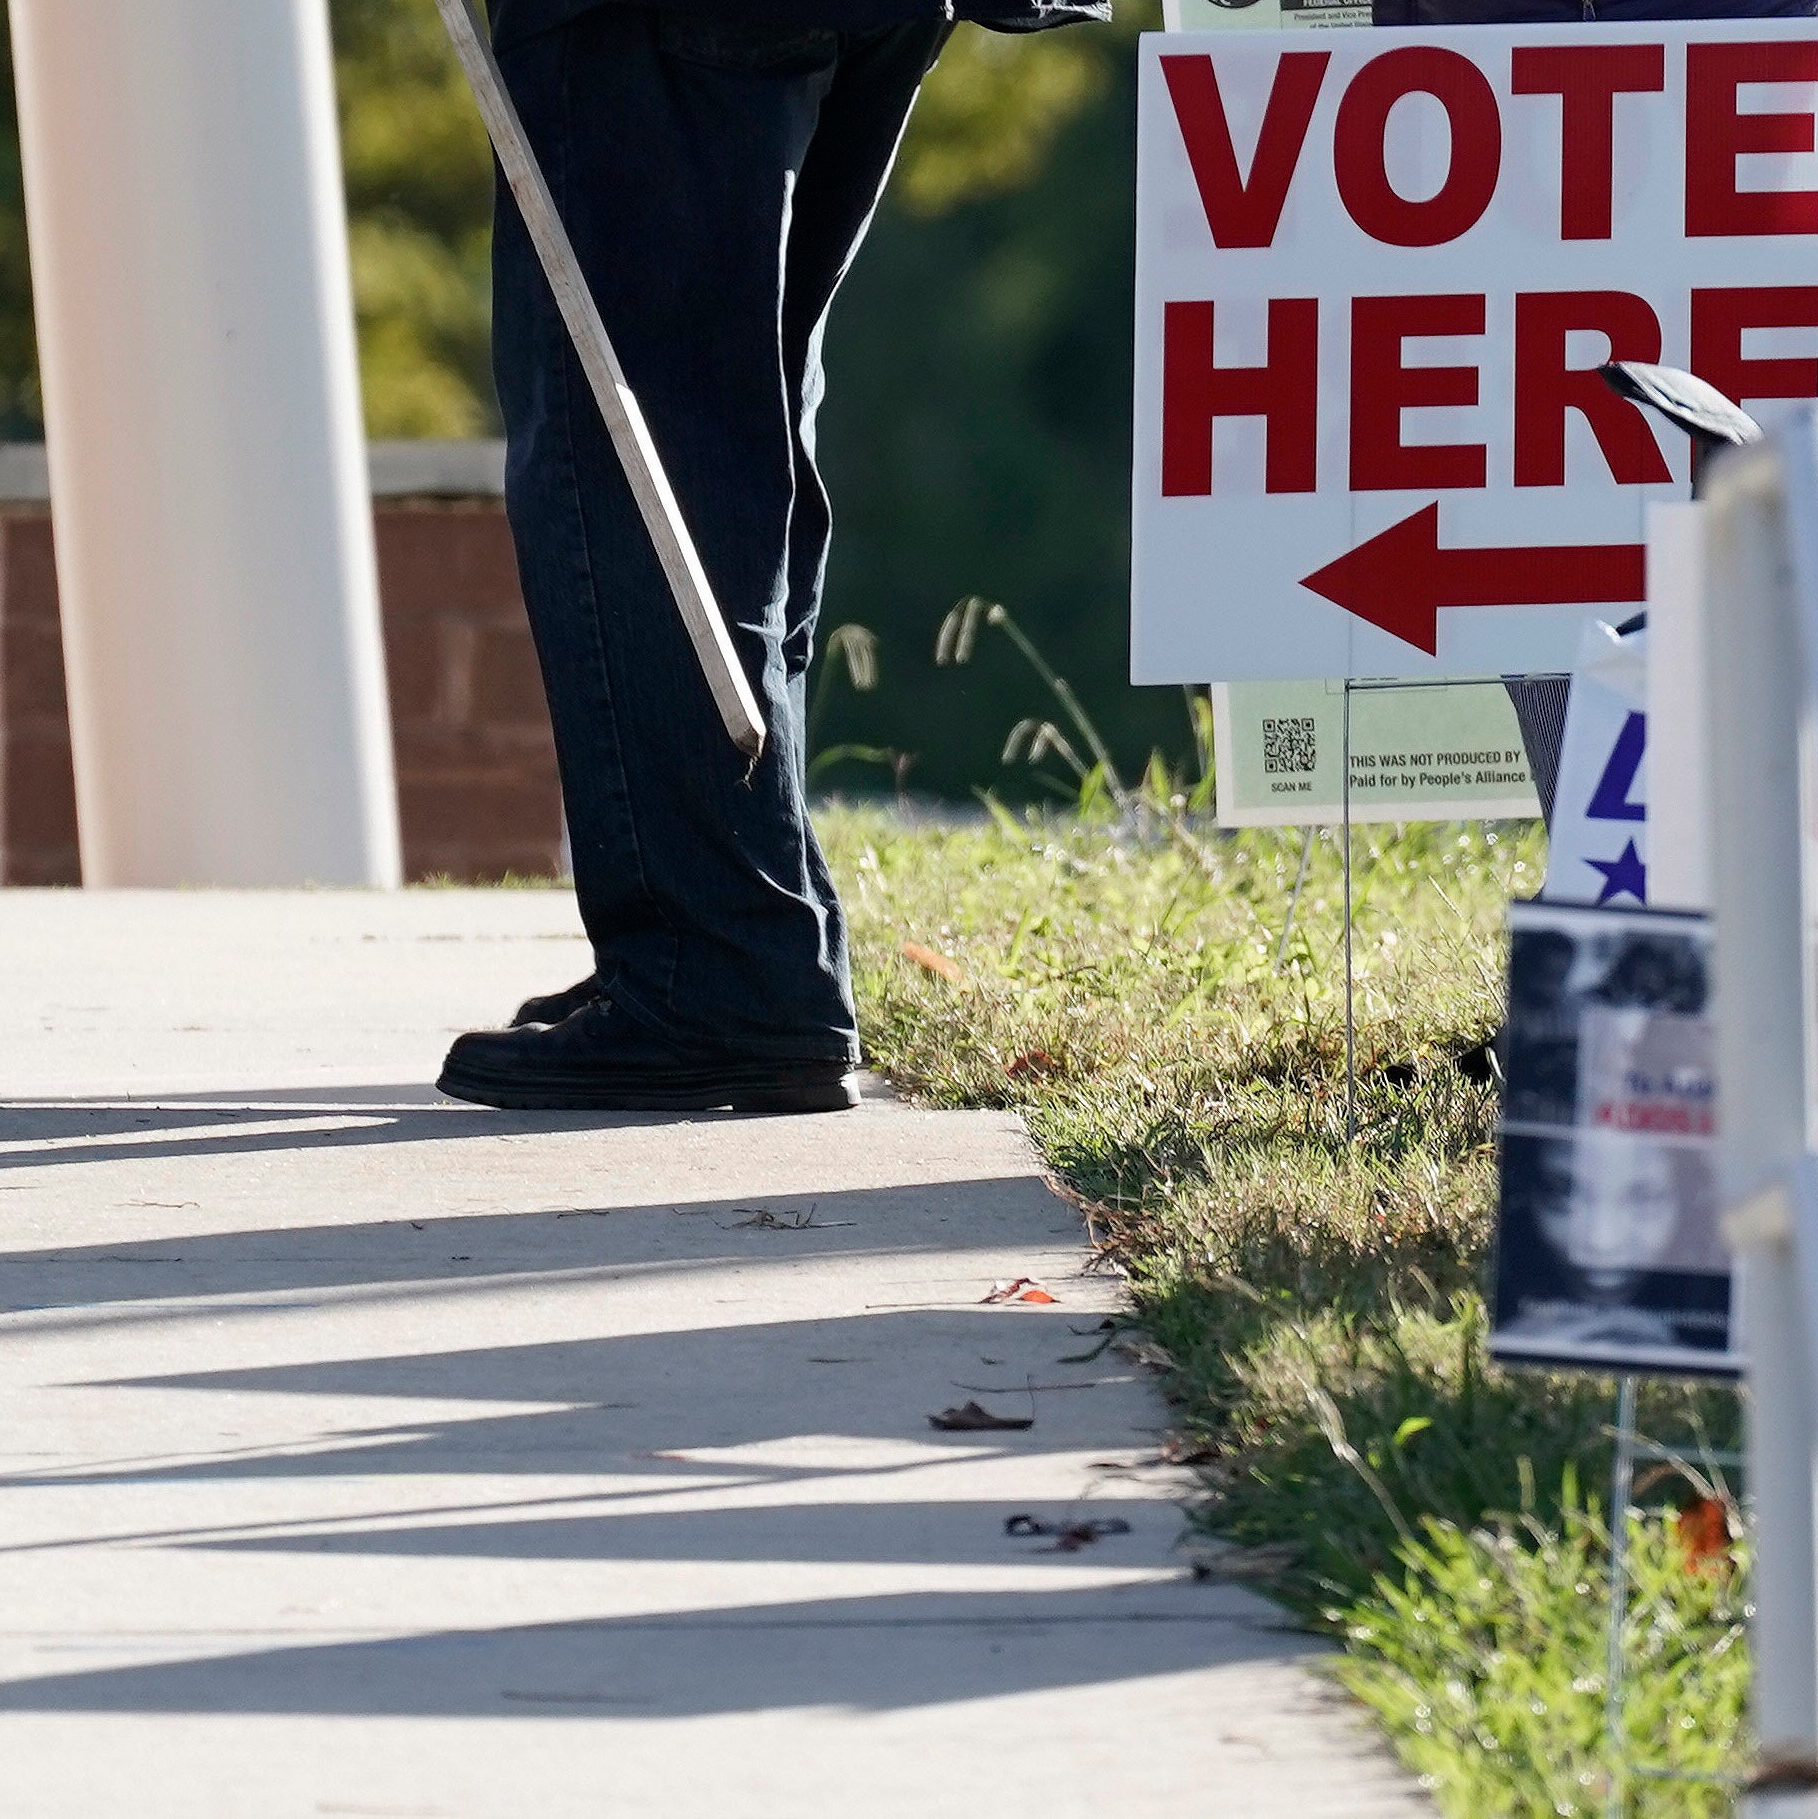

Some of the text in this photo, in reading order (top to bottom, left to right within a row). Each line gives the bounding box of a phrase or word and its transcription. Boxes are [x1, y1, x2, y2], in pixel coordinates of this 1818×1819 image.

[1350, 750, 1521, 768] THIS WAS NOT PRODUCED BY
[1271, 781, 1312, 793] SCAN ME
[1350, 770, 1527, 790] Paid for by People's Alliance
